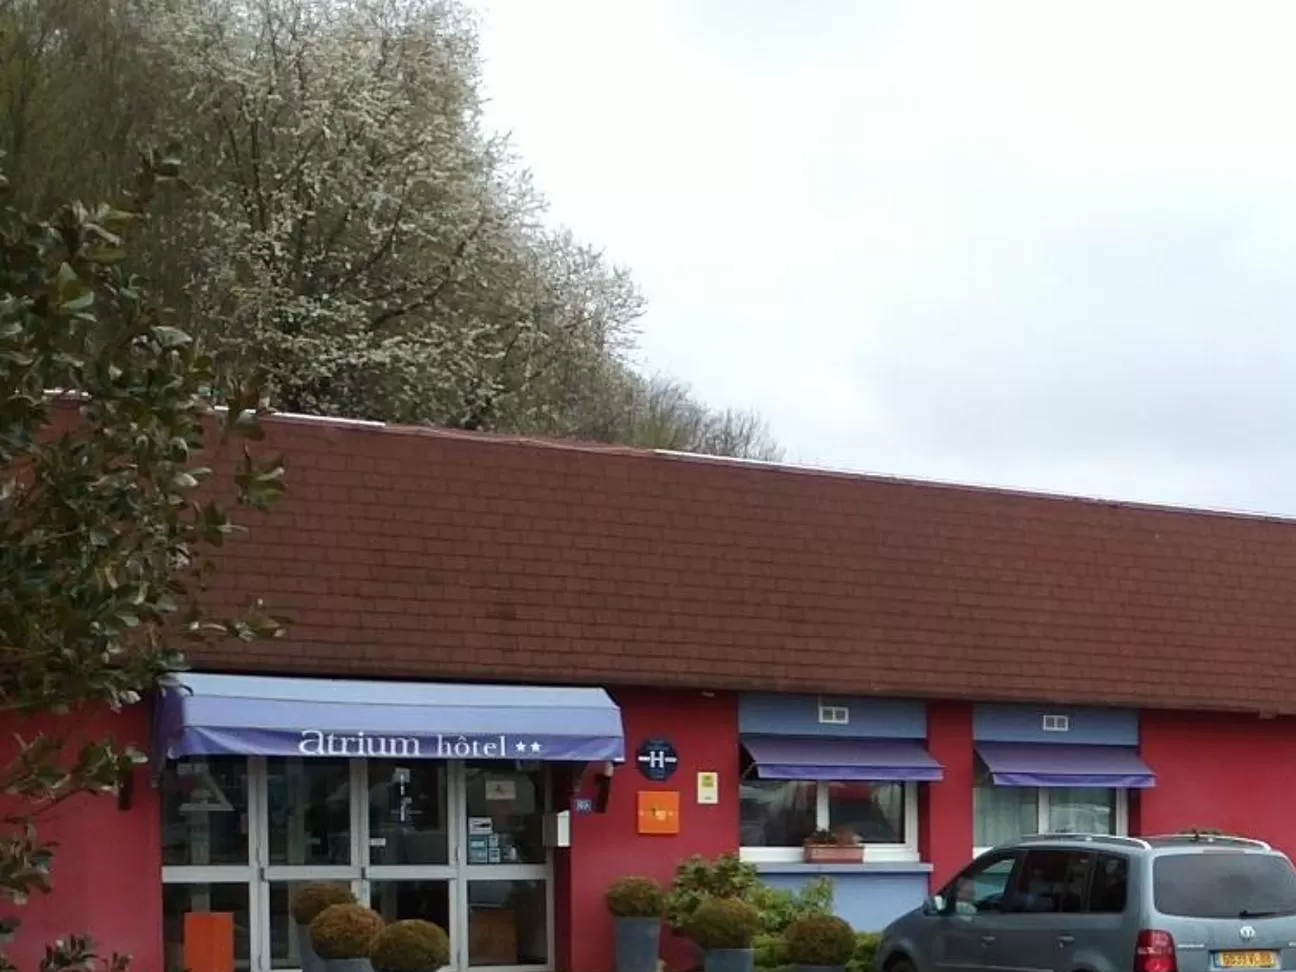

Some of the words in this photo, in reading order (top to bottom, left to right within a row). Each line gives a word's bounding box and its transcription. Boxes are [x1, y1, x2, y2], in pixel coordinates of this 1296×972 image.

[298, 729, 420, 756] atrium
[437, 733, 506, 757] hôtel
[649, 750, 665, 769] H
